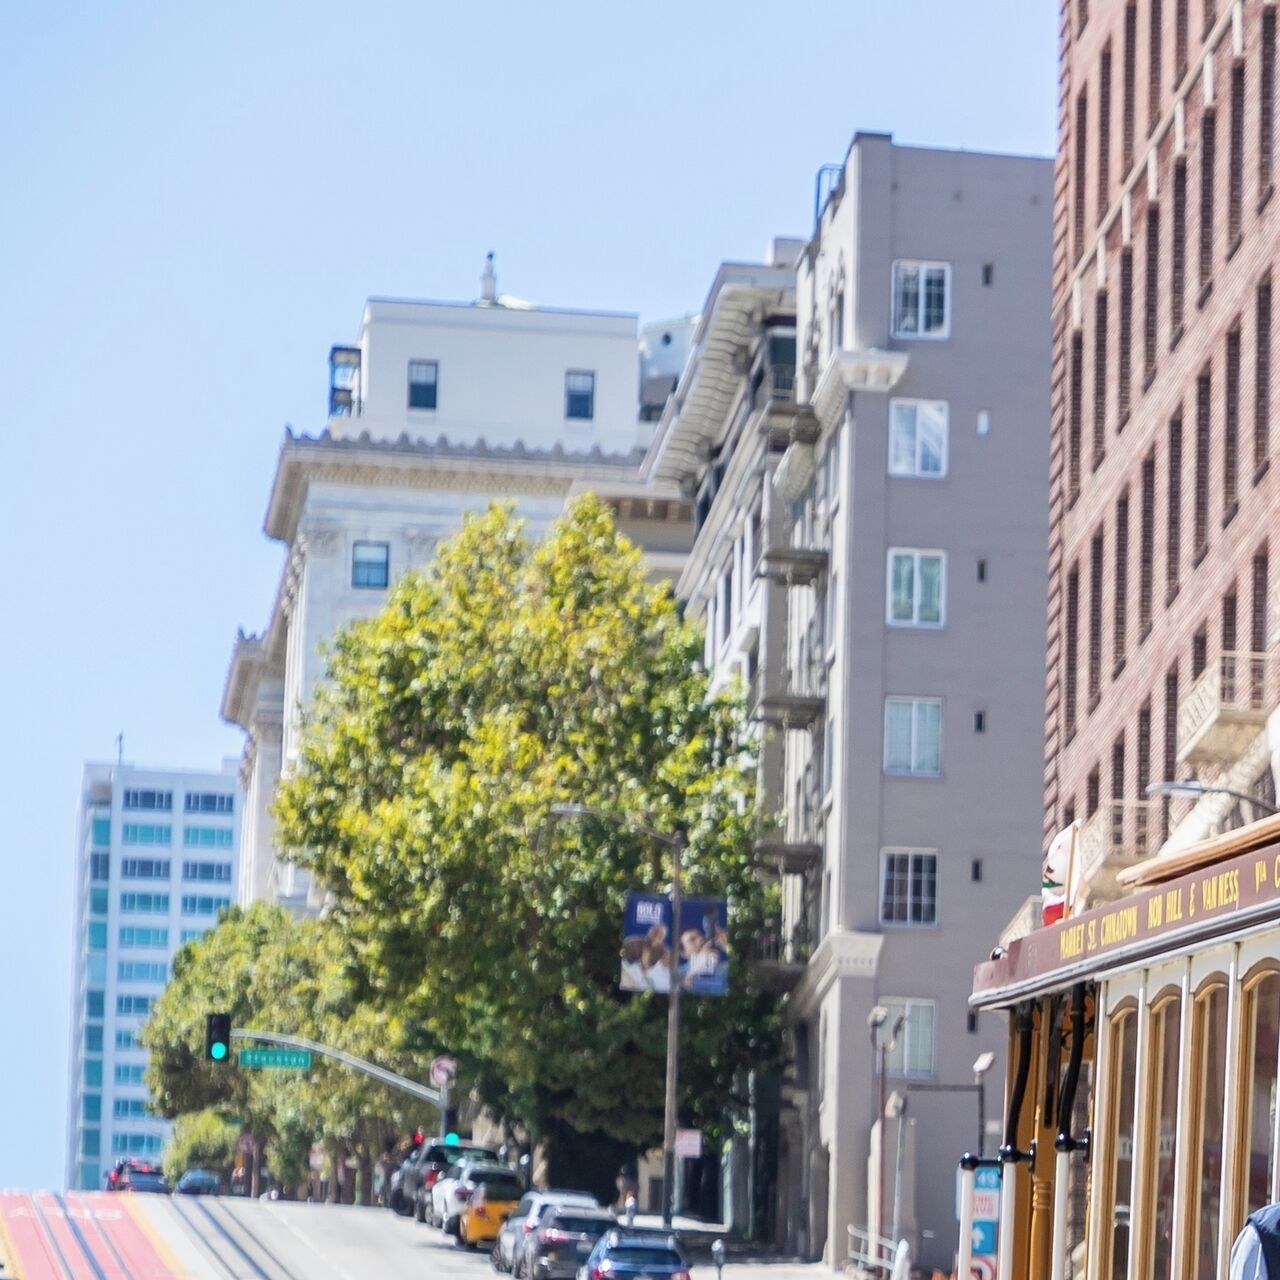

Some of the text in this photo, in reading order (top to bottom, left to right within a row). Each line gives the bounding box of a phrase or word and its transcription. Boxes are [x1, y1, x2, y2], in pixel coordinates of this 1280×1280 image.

[1101, 905, 1138, 946] CHINATOWN
[1148, 894, 1163, 929] NOB
[1166, 888, 1183, 923] HILL
